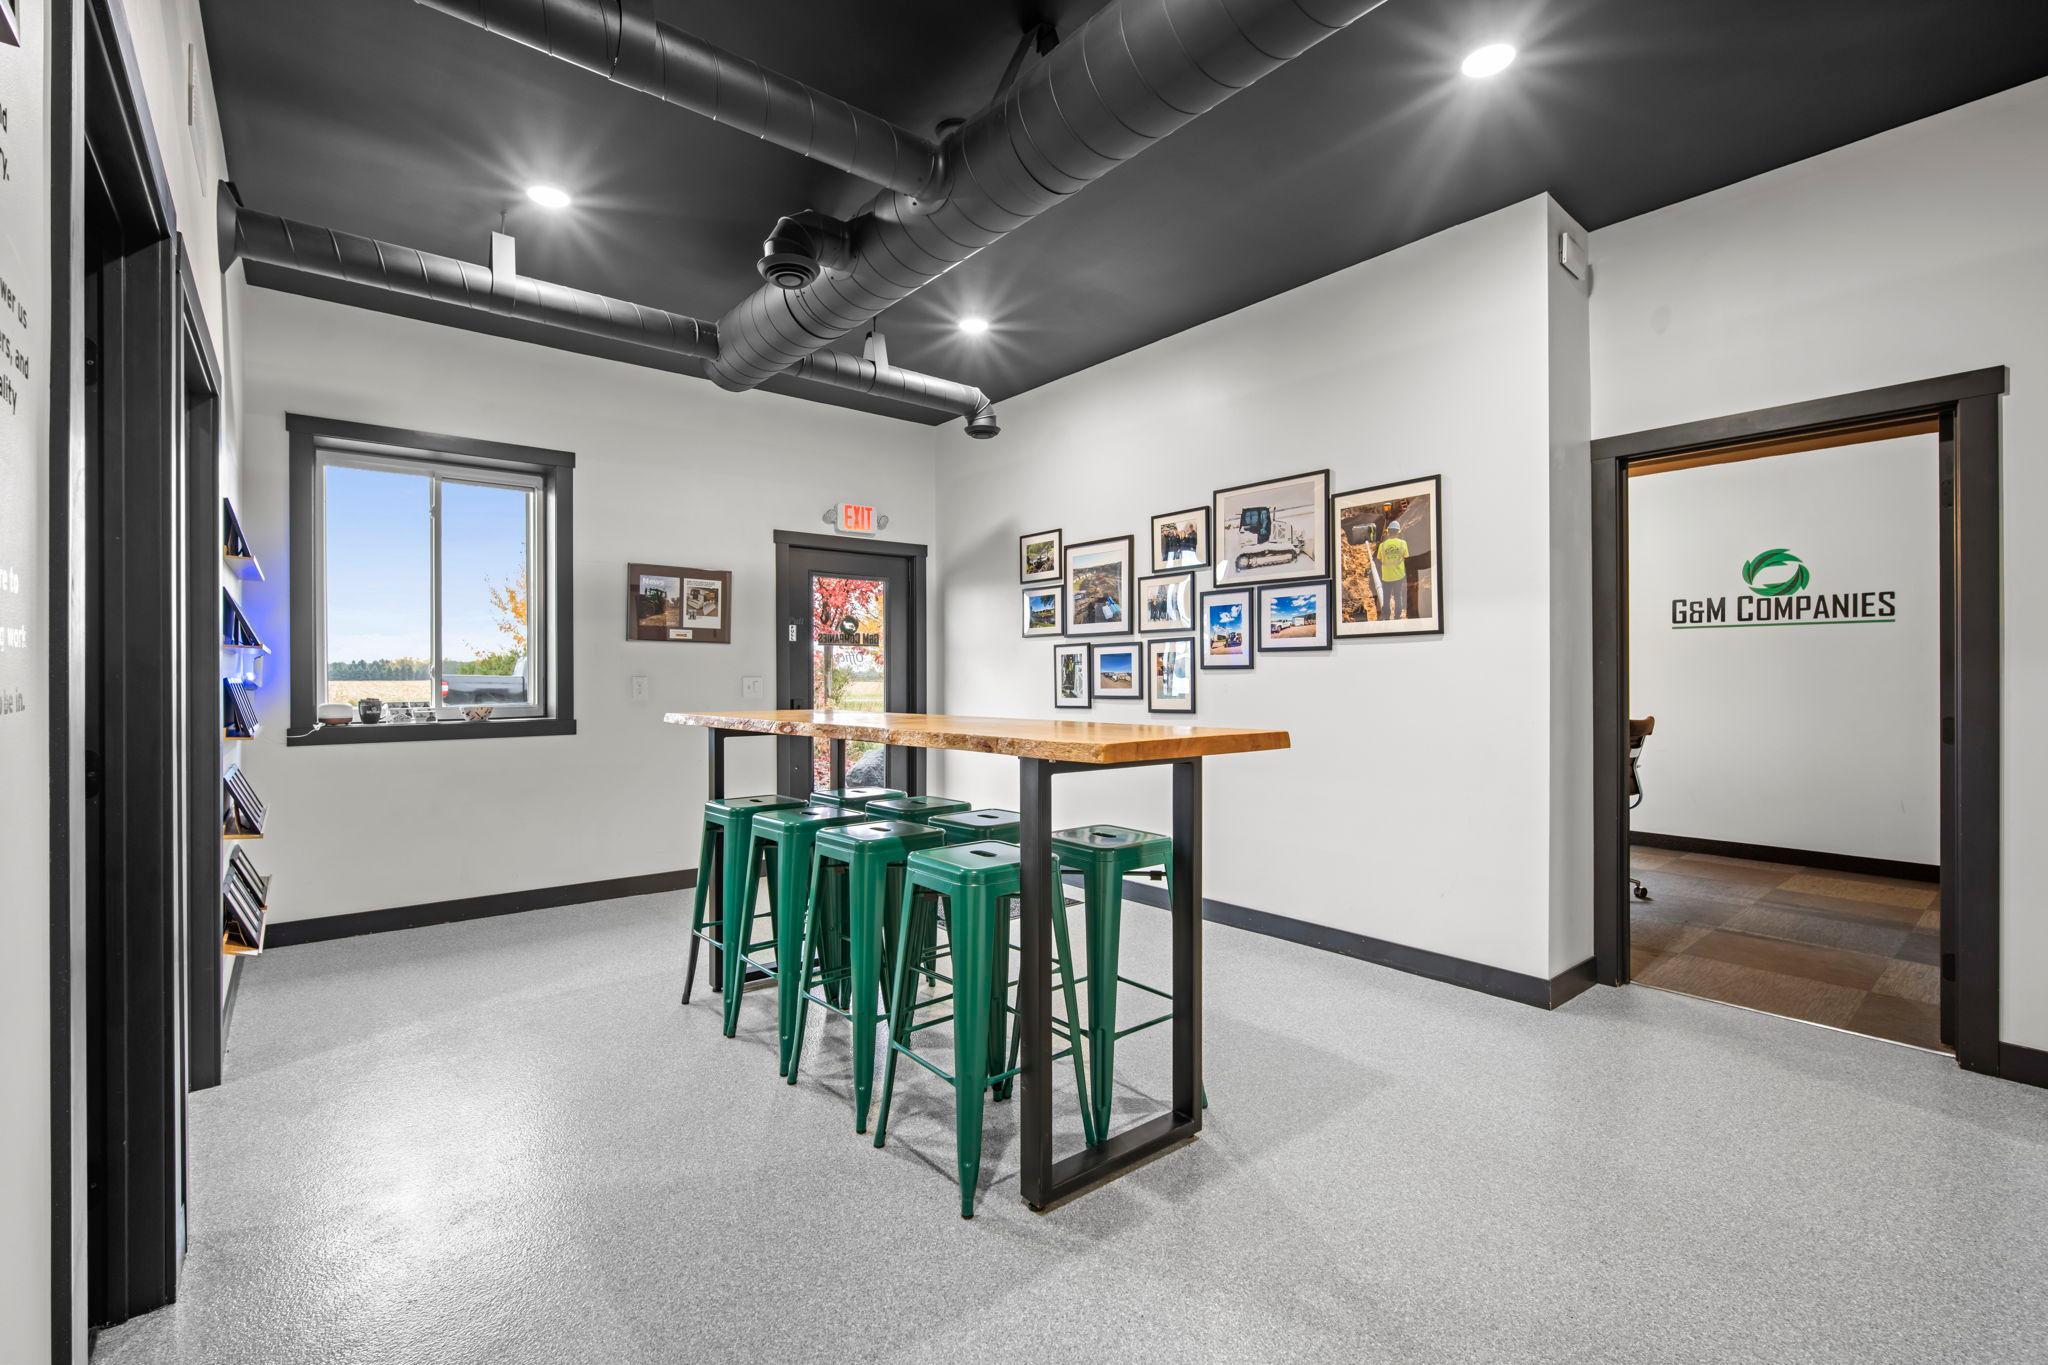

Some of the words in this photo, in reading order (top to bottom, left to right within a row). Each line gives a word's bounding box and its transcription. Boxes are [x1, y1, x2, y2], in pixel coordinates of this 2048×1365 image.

[18, 302, 28, 329] us
[15, 349, 29, 380] and
[844, 504, 873, 529] EXIT
[1672, 597, 1726, 624] G&M
[1737, 591, 1896, 622] COMPANIES
